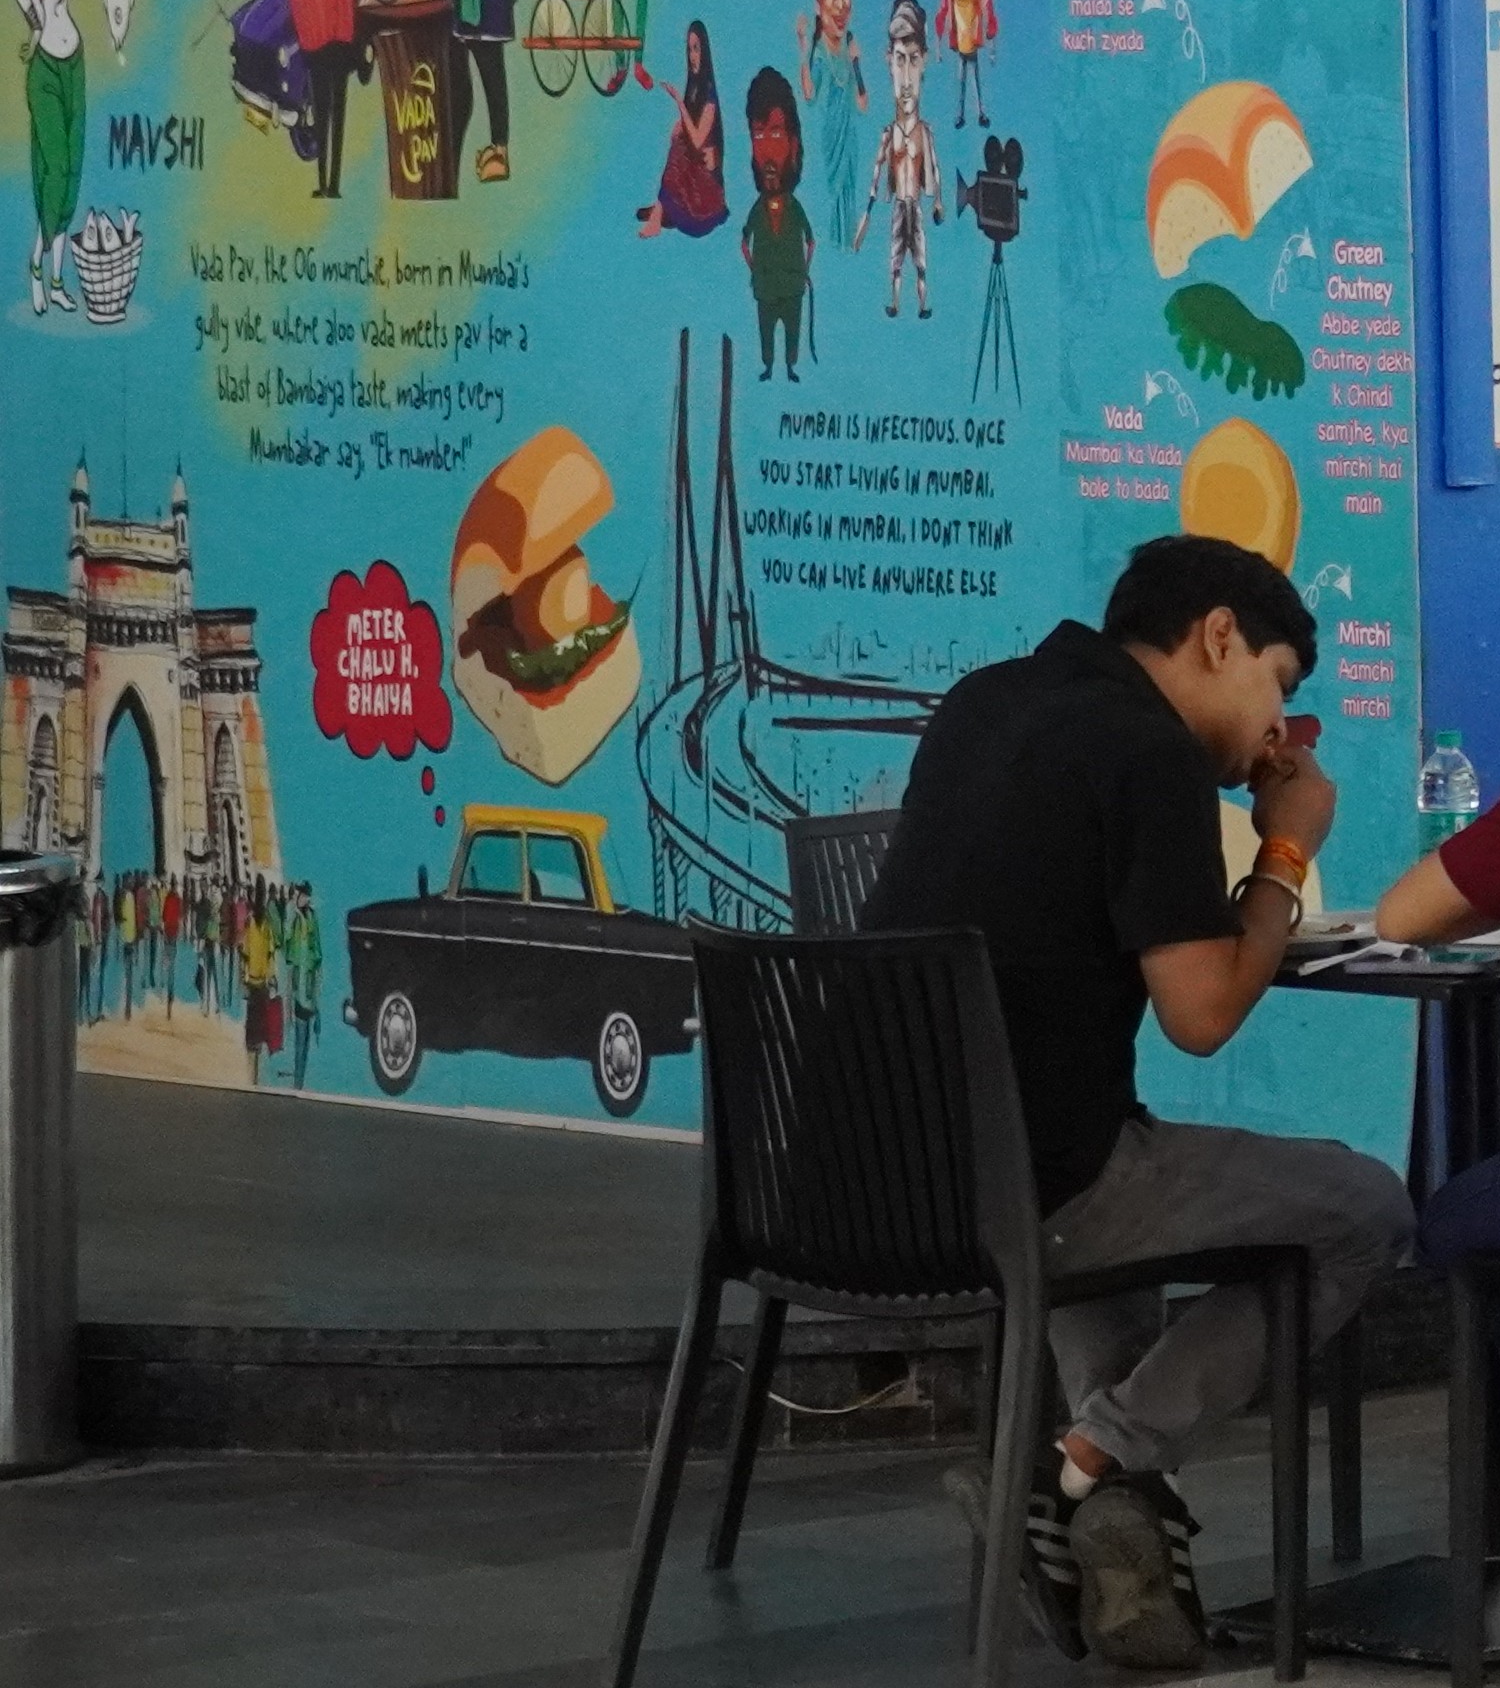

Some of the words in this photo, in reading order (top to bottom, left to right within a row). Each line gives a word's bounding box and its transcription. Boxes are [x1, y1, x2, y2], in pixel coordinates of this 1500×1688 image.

[1061, 30, 1096, 52] kuch
[1100, 31, 1145, 56] zyada
[107, 114, 206, 175] MAVSHI
[190, 244, 225, 282] Vada
[264, 246, 290, 284] the
[395, 249, 432, 286] born
[459, 249, 530, 289] Mumbai's
[1334, 239, 1384, 267] Green
[1327, 275, 1394, 307] Chutney
[272, 306, 319, 346] where
[361, 308, 396, 348] vada
[400, 311, 448, 349] meets
[1320, 315, 1360, 337] Abbe
[1364, 315, 1401, 339] yede
[1312, 348, 1371, 376] Chutney
[1374, 351, 1413, 373] dekh
[396, 371, 452, 421] making
[1346, 383, 1393, 407] Chindi
[779, 412, 842, 440] MUMBAI
[846, 414, 861, 441] IS
[865, 414, 960, 445] INFECTIOUS.
[964, 418, 1006, 448] ONCE
[1104, 405, 1145, 432] Vada
[1065, 441, 1123, 466] Mumbai
[1149, 444, 1183, 467] Vada
[1325, 456, 1373, 480] mirchi
[1378, 458, 1402, 480] hai
[760, 459, 791, 485] YOU
[796, 461, 844, 490] START
[848, 464, 900, 494] LIVING
[905, 467, 921, 495] IN
[1078, 477, 1110, 500] bole
[1134, 478, 1171, 502] bada
[1345, 493, 1382, 515] main
[743, 507, 813, 539] WORKING
[818, 513, 833, 540] IN
[921, 519, 962, 549] DONT
[967, 519, 1015, 551] THINK
[762, 557, 793, 585] YOU
[798, 561, 828, 592] CAN
[832, 562, 867, 590] LIVE
[871, 566, 955, 597] ANYWHERE
[960, 570, 998, 598] ELSE
[346, 609, 406, 647] METER
[1338, 620, 1392, 647] Mirchi
[336, 646, 396, 680] CHALU
[1338, 657, 1395, 682] Aamchi
[347, 681, 413, 717] BHAIYA
[1342, 695, 1391, 719] mirchi
